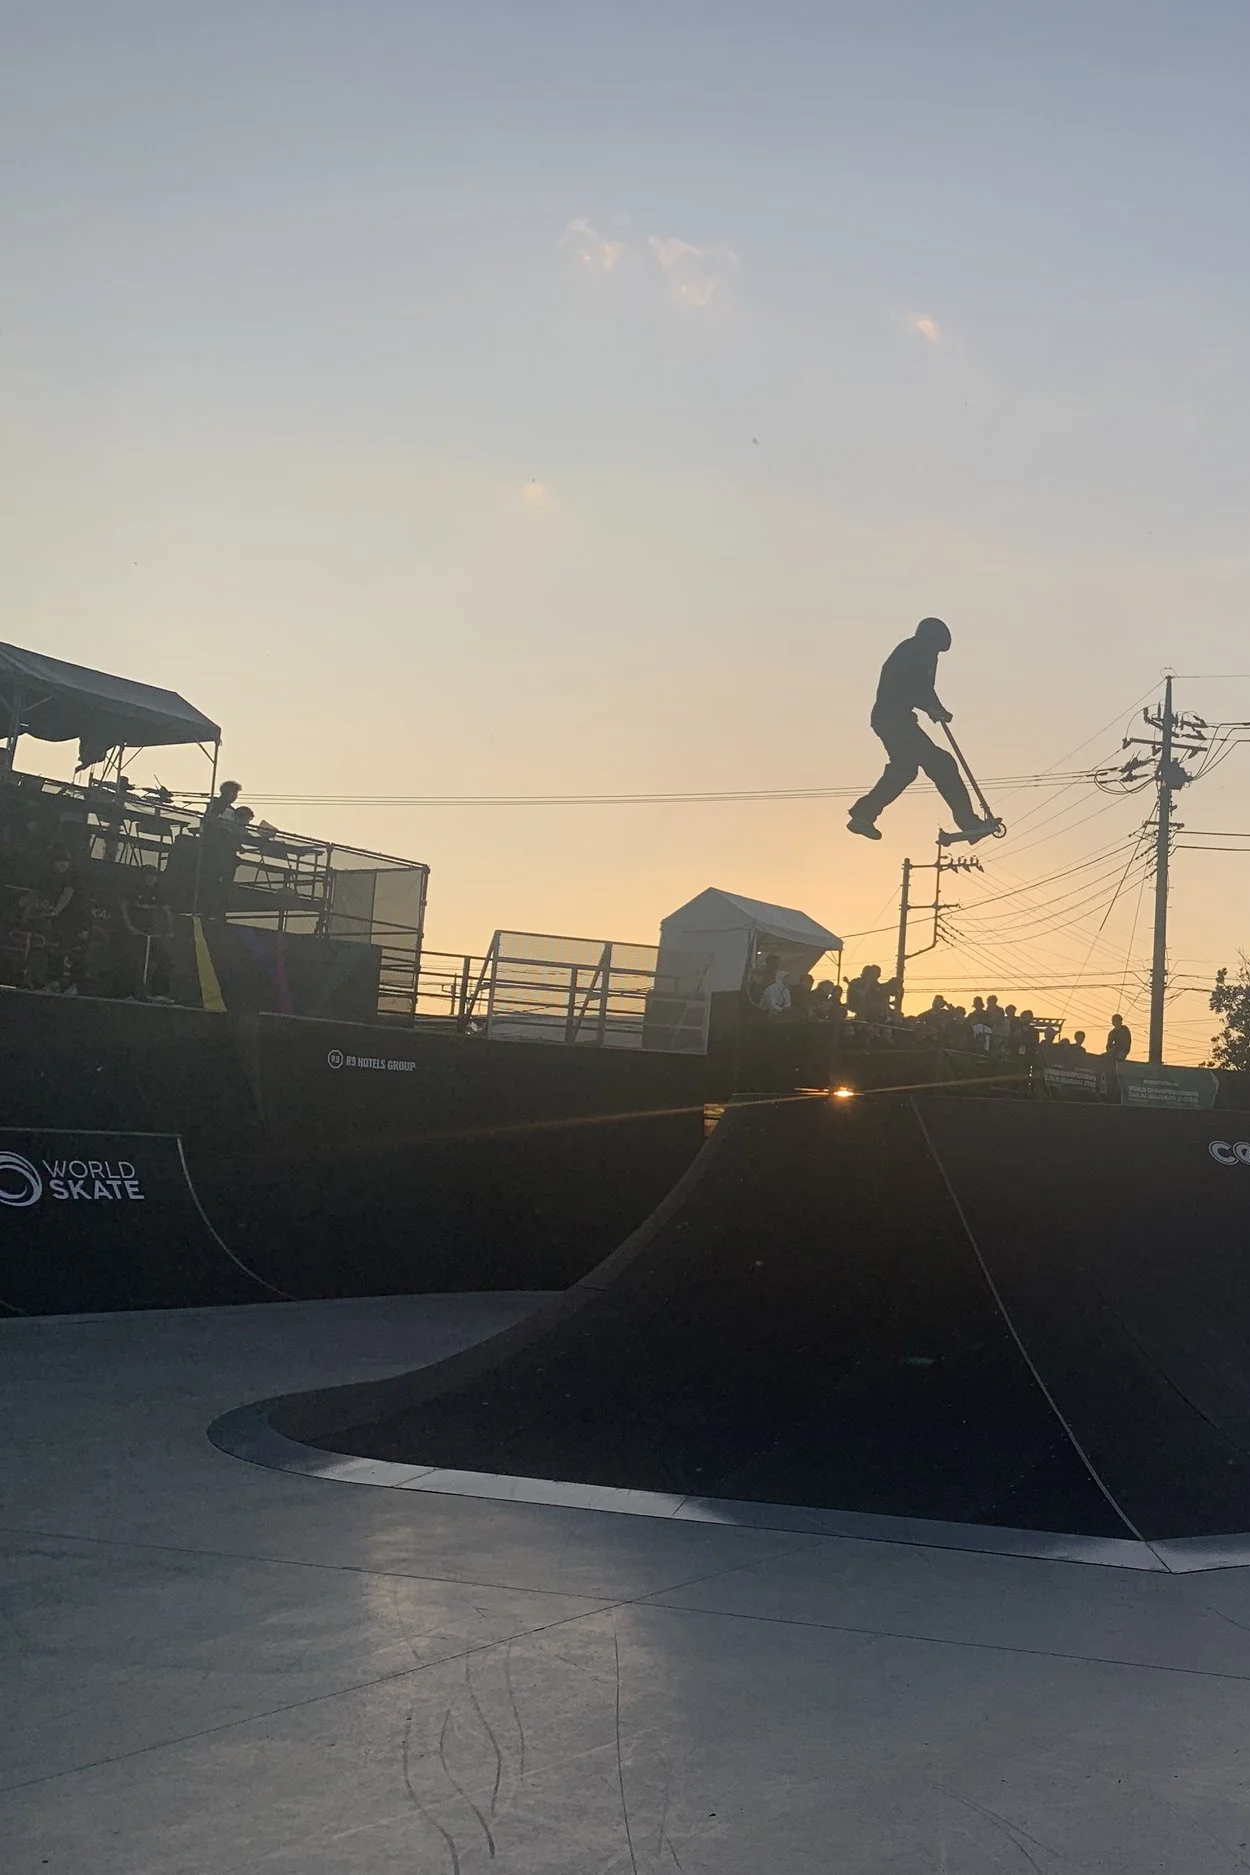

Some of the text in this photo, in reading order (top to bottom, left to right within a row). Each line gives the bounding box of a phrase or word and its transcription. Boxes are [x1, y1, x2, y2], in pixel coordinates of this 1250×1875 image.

[346, 1055, 416, 1072] R9 HOTELS GROUP
[42, 1159, 136, 1179] WORLD
[50, 1179, 145, 1200] SKATE
